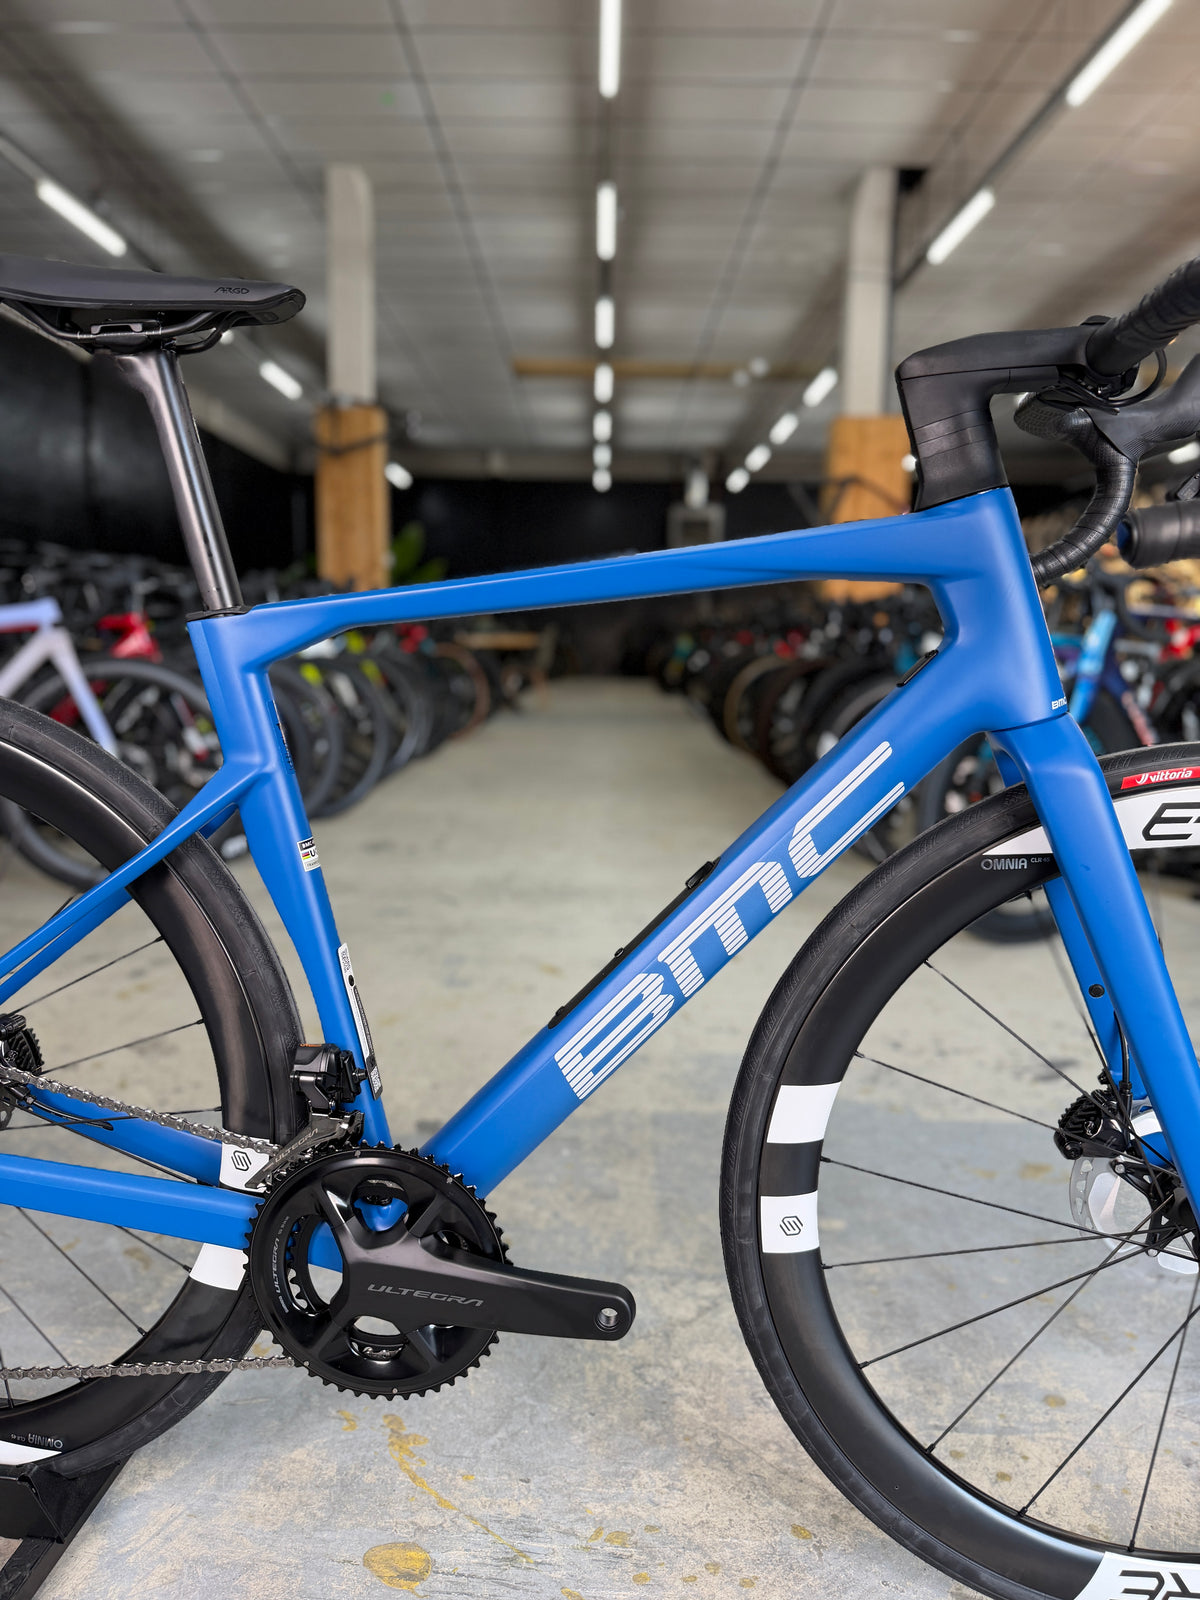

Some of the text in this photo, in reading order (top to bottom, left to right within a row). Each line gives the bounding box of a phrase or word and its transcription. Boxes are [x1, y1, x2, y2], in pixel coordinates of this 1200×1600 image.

[214, 286, 250, 294] ARGO
[1149, 768, 1193, 783] vittoria
[1141, 802, 1200, 841] E
[981, 857, 1028, 871] OMNIA
[271, 1237, 281, 1294] ULTEGRA
[367, 1283, 484, 1307] ULTEGRA
[28, 1433, 63, 1449] OMNIA
